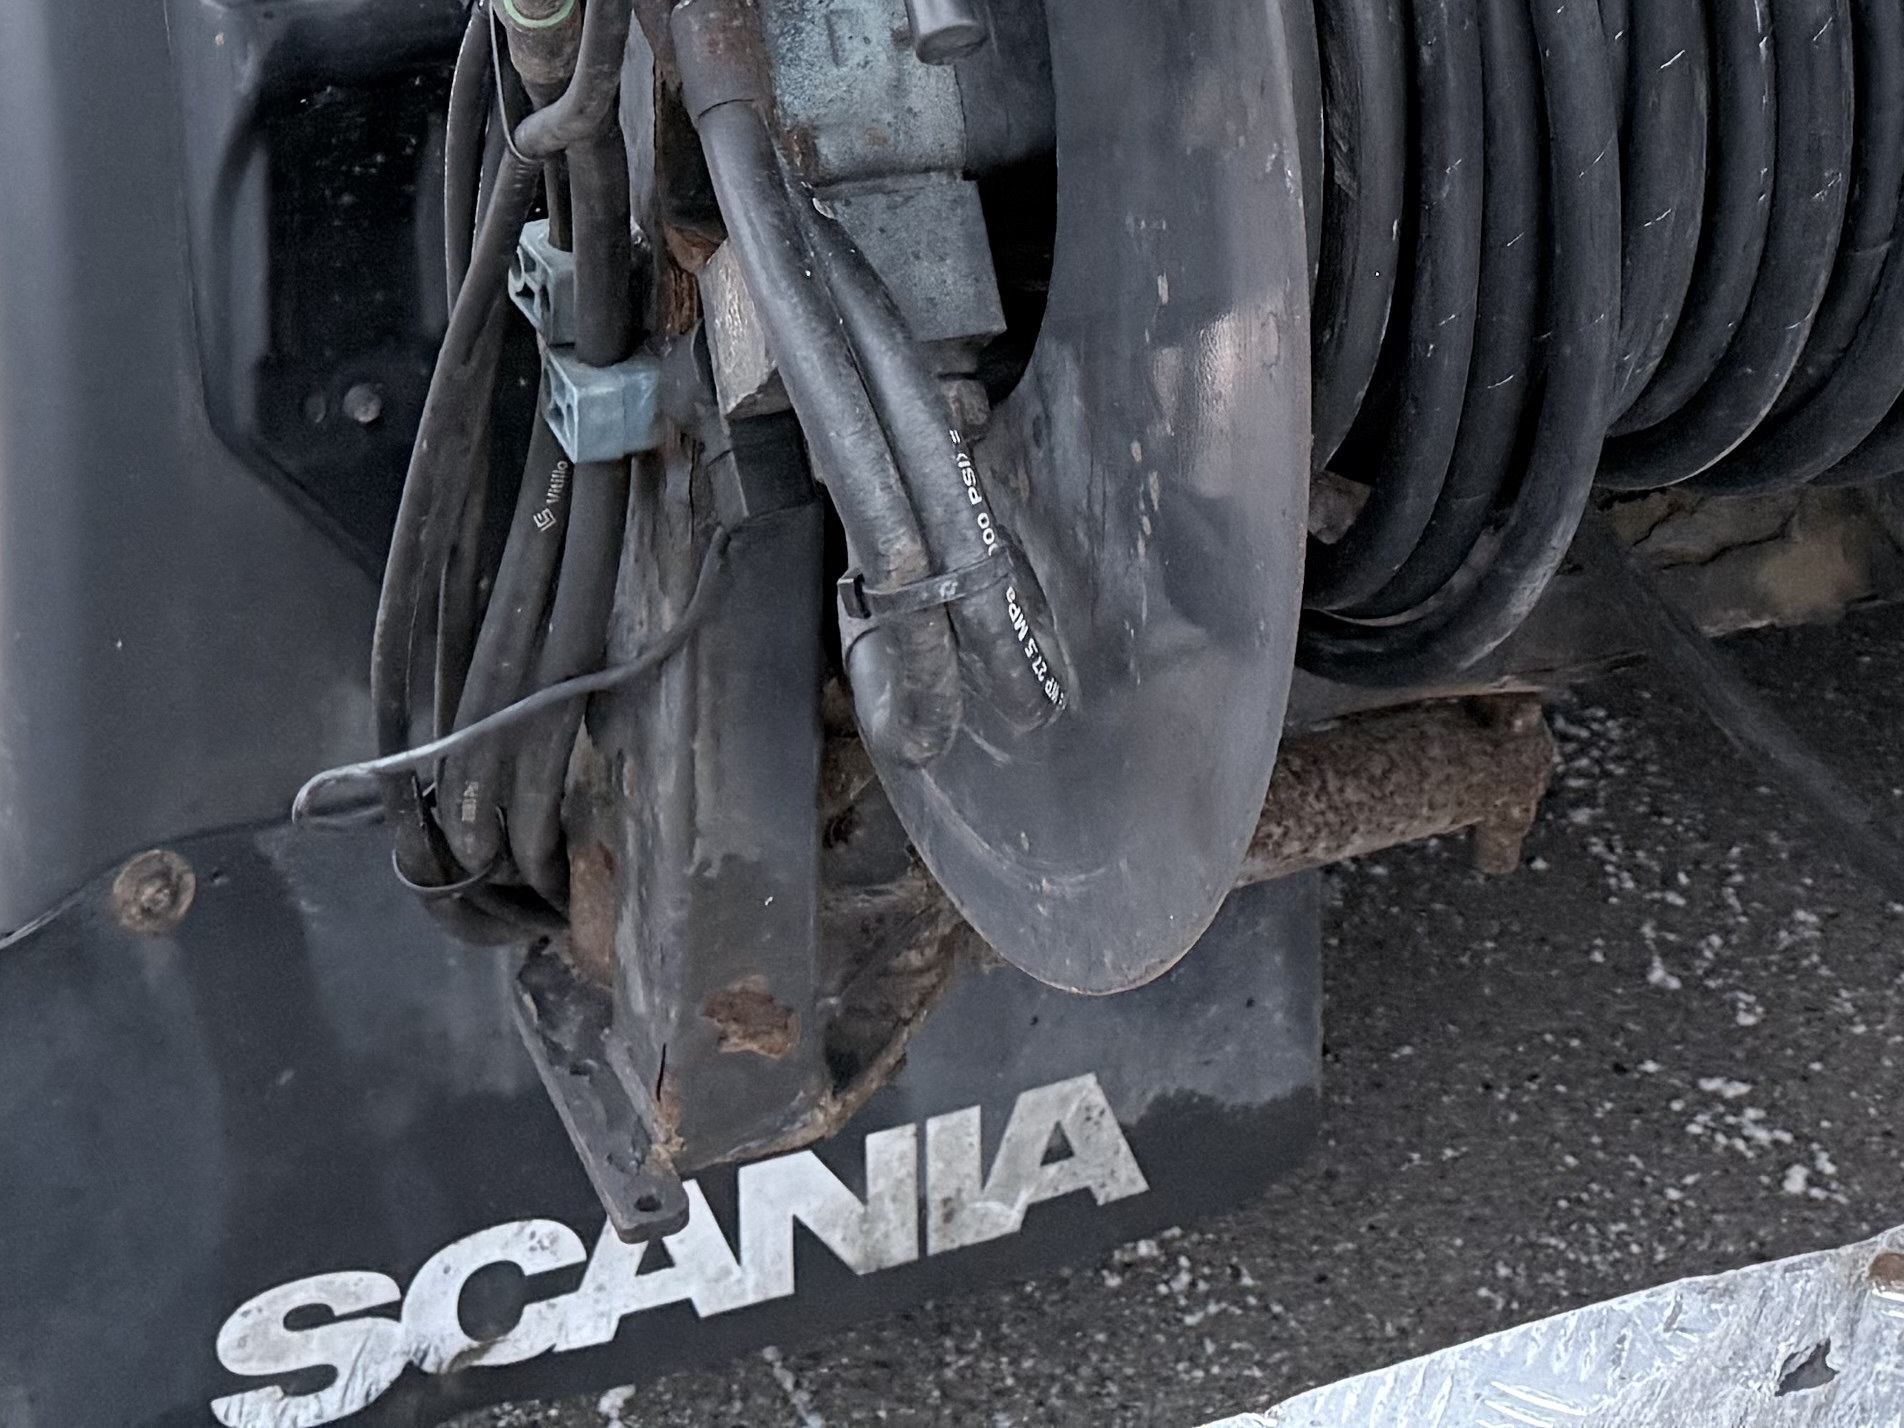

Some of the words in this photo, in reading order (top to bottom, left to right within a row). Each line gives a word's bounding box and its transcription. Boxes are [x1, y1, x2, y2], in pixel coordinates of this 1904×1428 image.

[546, 460, 569, 504] Vitillo
[955, 452, 983, 505] PSI)
[1005, 586, 1028, 641] MPa
[211, 1072, 1151, 1428] SCANIA
